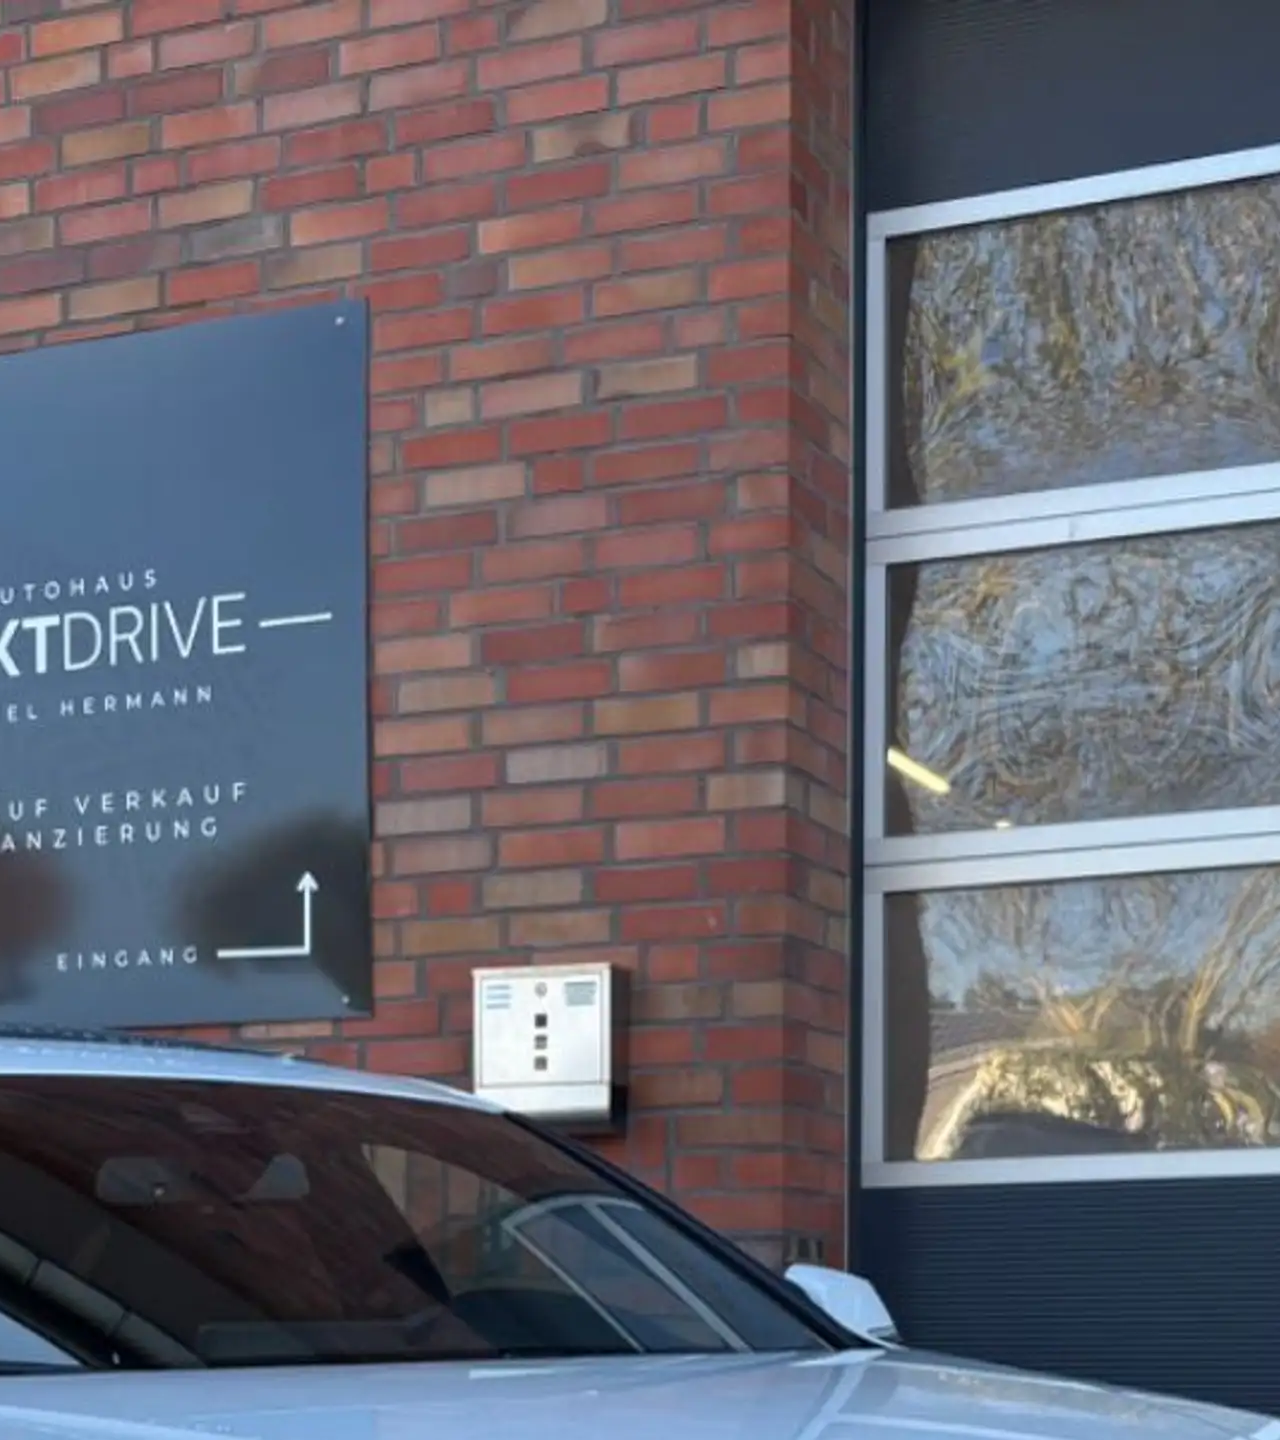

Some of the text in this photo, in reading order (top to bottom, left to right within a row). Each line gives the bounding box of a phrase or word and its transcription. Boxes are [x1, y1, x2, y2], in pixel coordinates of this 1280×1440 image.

[60, 685, 212, 717] HERMANN
[74, 781, 247, 815] VERKAUF
[56, 946, 198, 972] EINGANG
